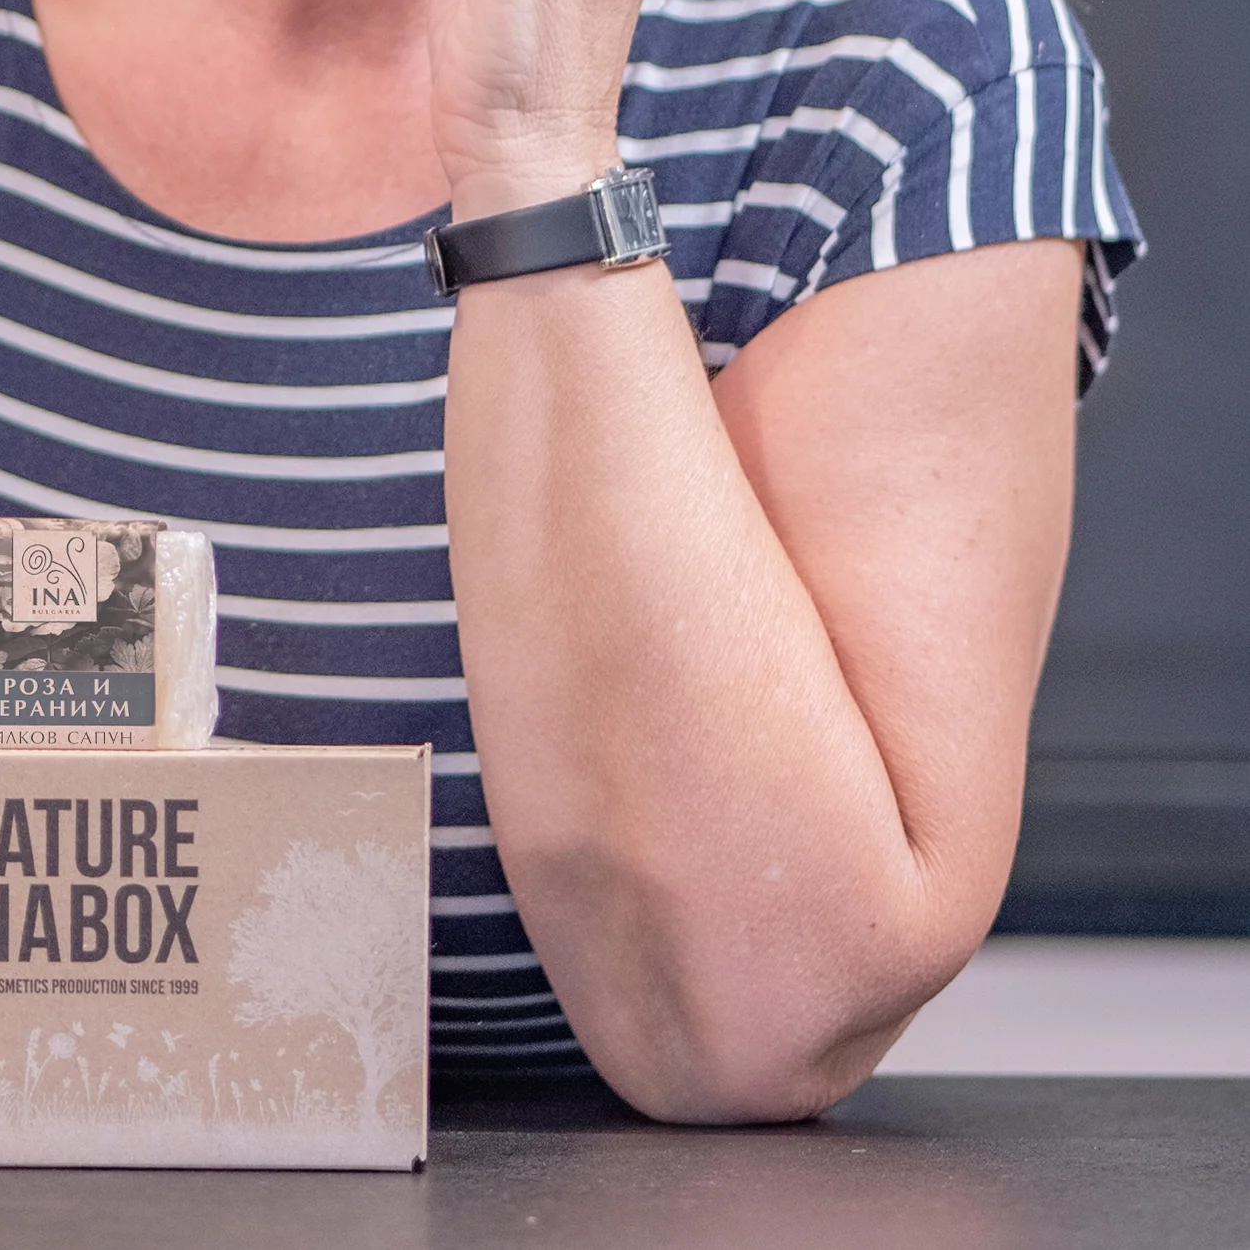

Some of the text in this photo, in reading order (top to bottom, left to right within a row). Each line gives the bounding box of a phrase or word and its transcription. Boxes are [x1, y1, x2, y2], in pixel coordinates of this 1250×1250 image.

[32, 587, 80, 606] INA
[4, 677, 110, 696] РОЗА И
[67, 730, 134, 745] САПУН
[52, 979, 127, 994] PRODUCTION
[130, 979, 165, 995] SINCE
[168, 979, 199, 995] 1999
